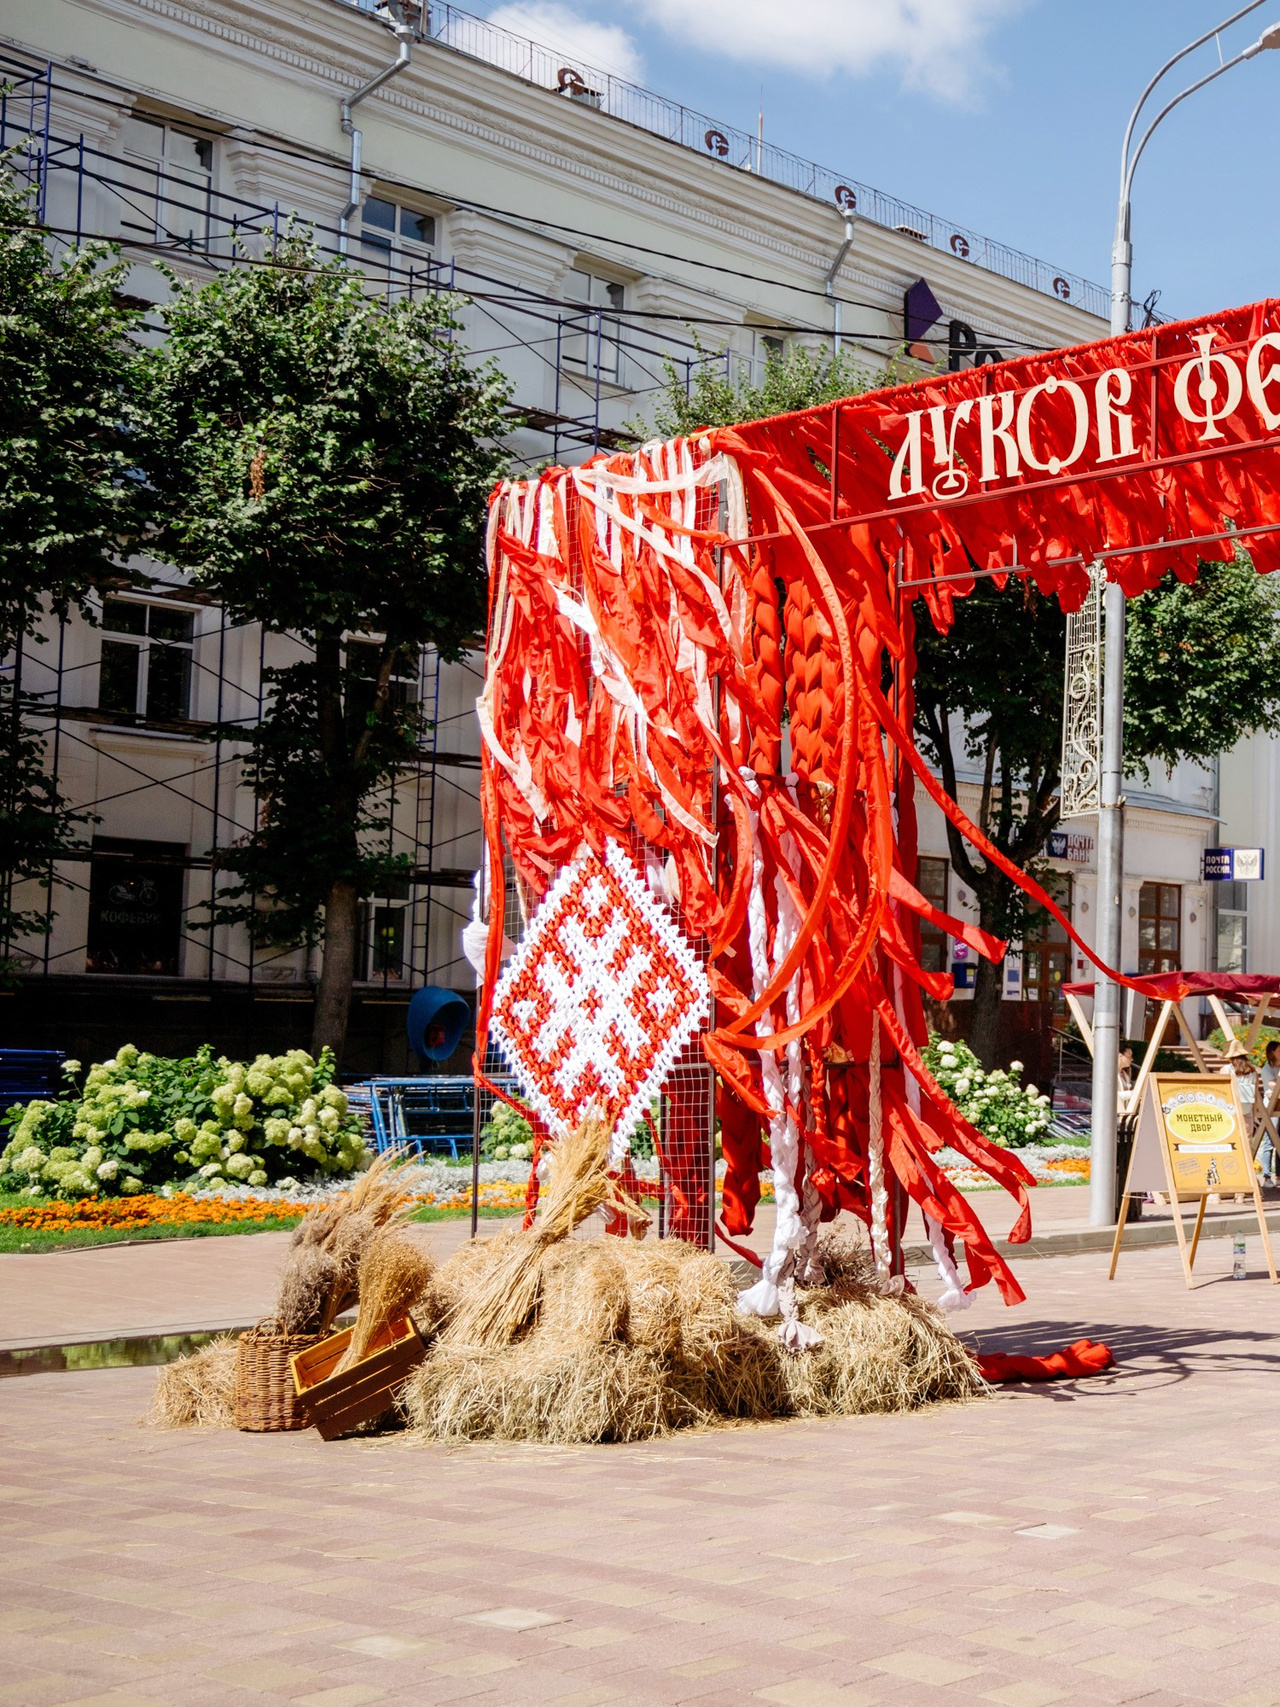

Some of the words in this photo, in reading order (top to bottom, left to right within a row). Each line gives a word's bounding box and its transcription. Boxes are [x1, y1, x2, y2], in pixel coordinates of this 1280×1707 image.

[1067, 834, 1094, 849] ПОЧТА
[1205, 855, 1230, 865] ПОЧТА
[1176, 1113, 1223, 1122] МОНЕТНЫЙ
[1190, 1124, 1212, 1132] ДВОР
